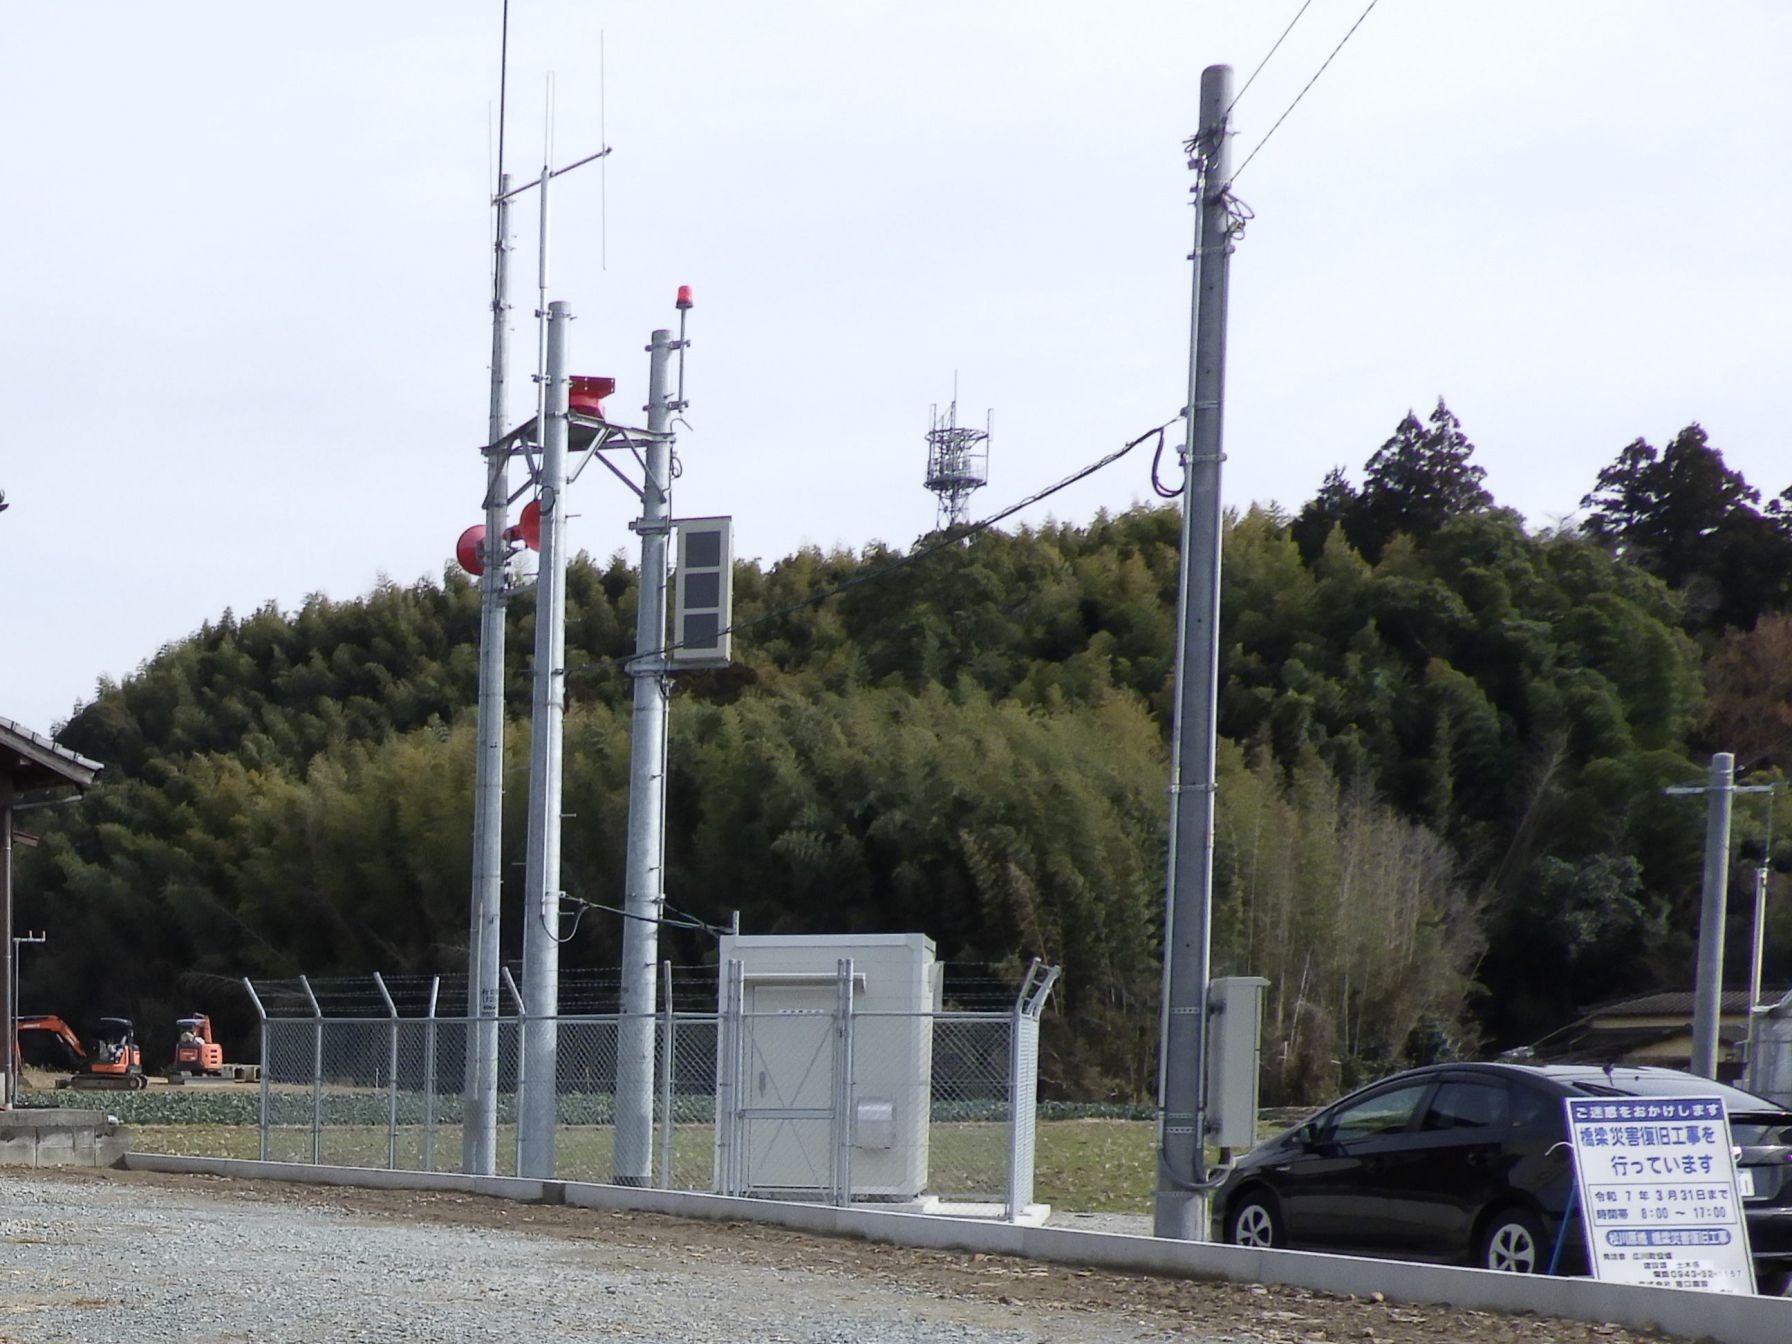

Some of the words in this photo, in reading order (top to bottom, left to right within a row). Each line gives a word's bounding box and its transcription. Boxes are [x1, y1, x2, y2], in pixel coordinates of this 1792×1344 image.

[1575, 1104, 1719, 1119] ご迷惑をおかけします
[1579, 1126, 1716, 1147] 橋梁災害復旧工事を
[1611, 1154, 1713, 1176] 行っています
[1597, 1209, 1628, 1221] 時間帯
